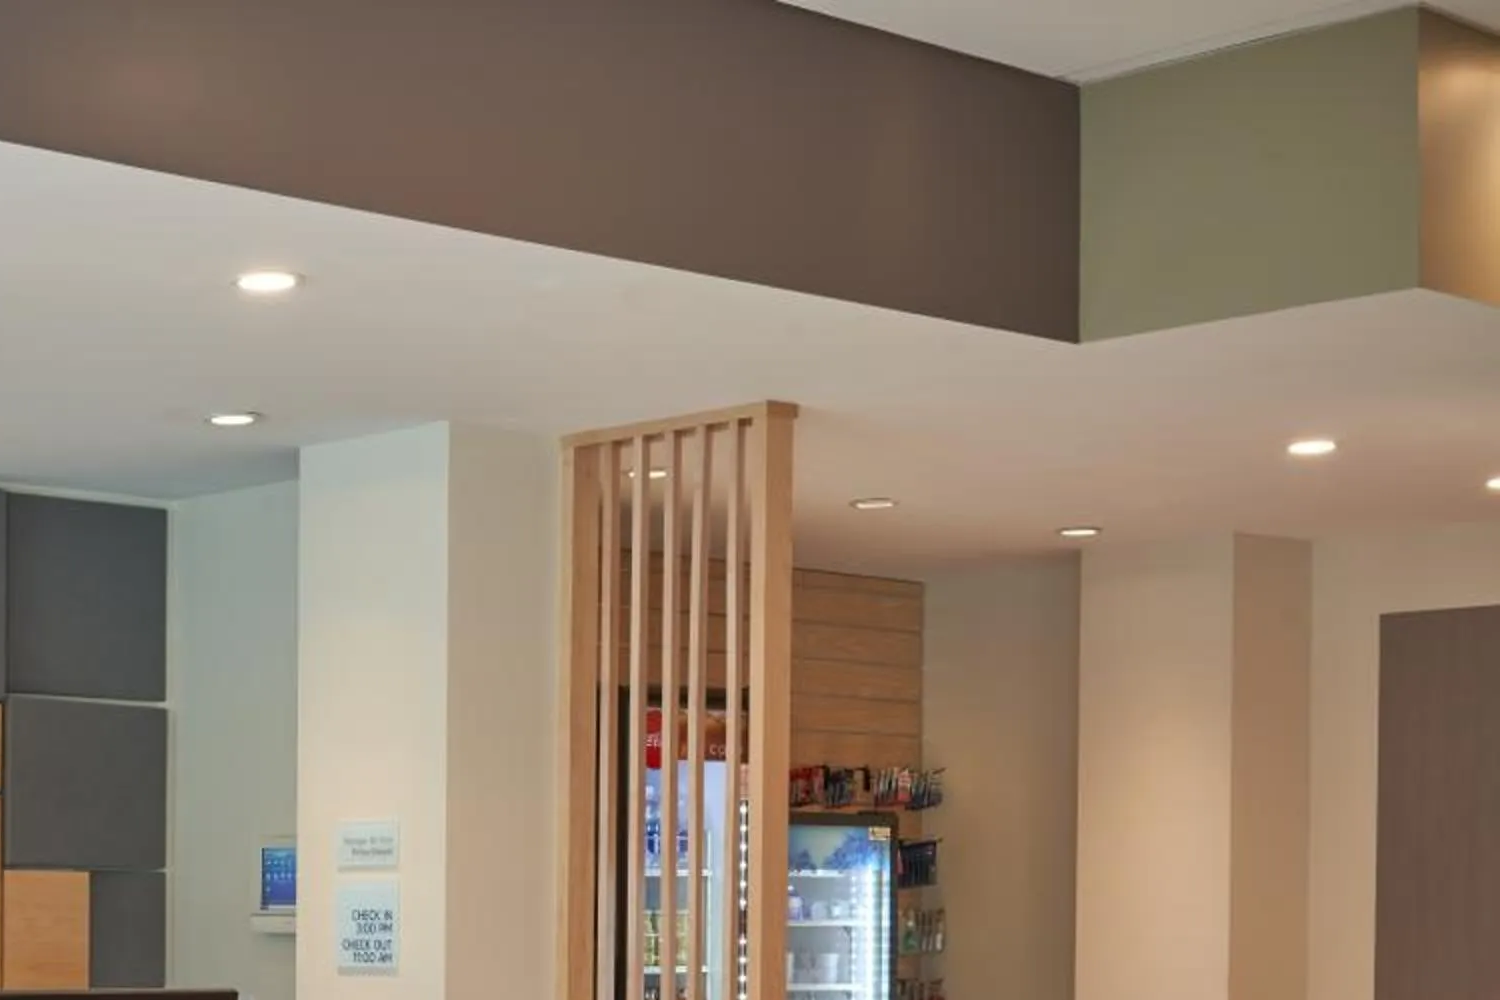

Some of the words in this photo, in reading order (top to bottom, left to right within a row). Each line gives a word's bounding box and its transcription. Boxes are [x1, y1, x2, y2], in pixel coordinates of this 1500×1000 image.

[351, 909, 381, 921] CHECK
[383, 909, 393, 921] IN
[341, 938, 371, 951] CHECK
[373, 938, 393, 951] OUT
[377, 951, 393, 963] AM
